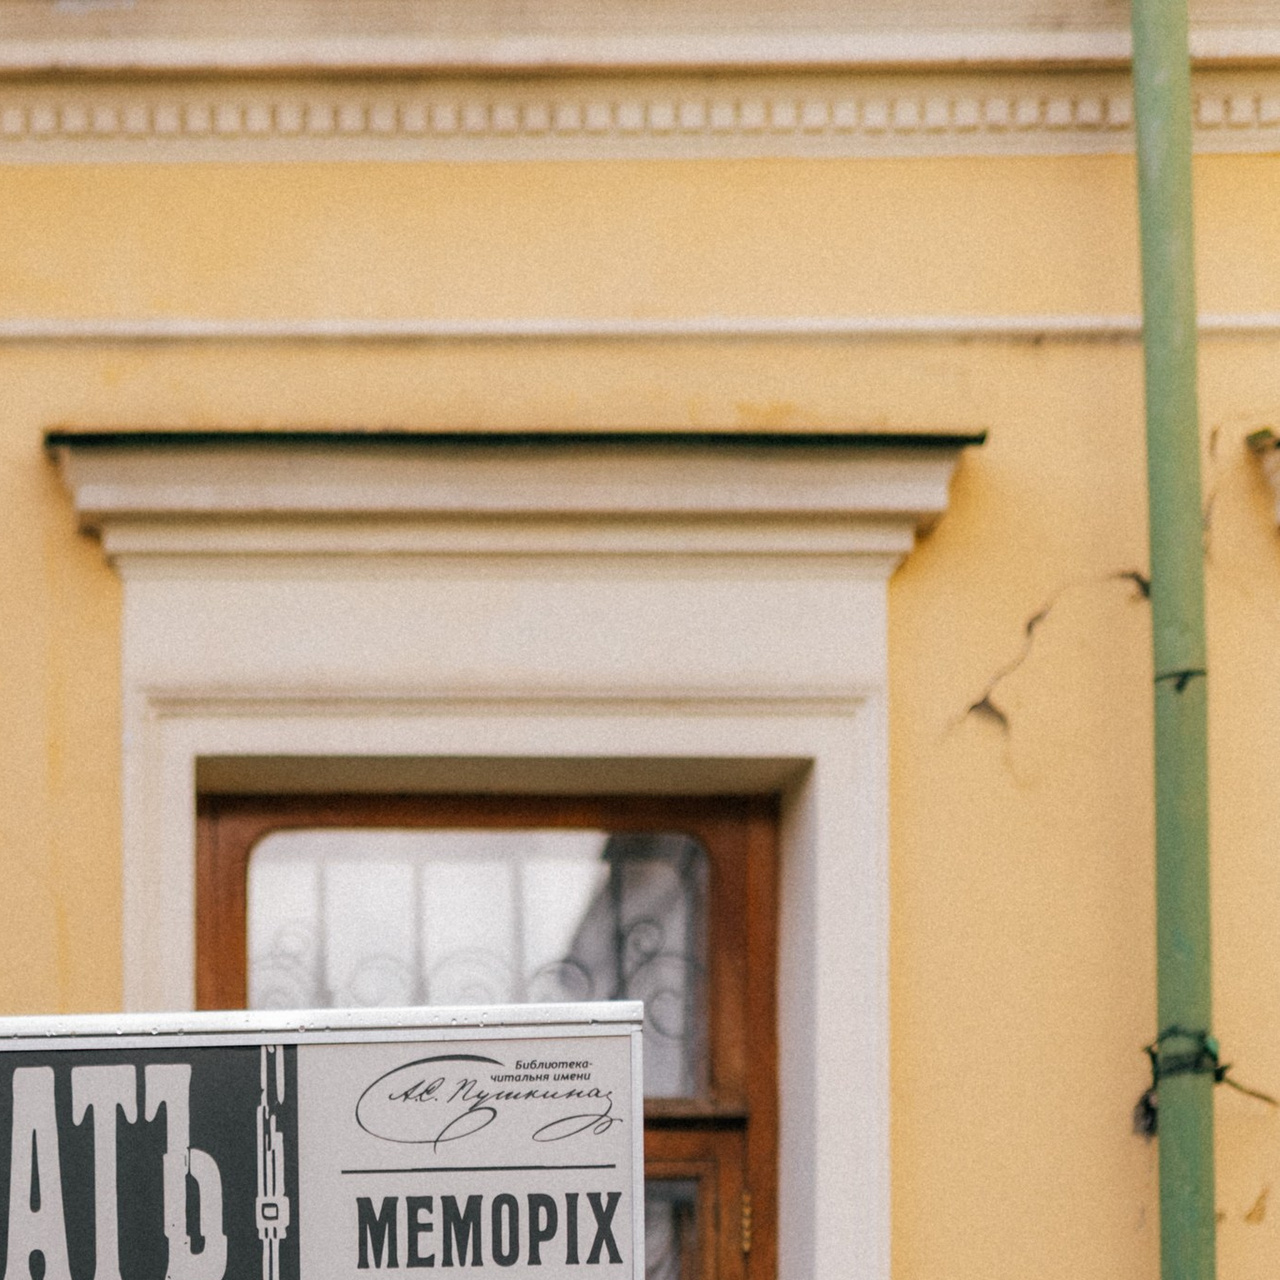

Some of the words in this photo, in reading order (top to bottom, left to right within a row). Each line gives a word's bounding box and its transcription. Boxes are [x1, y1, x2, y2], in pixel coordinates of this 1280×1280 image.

[515, 1060, 593, 1071] Библиотека-
[490, 1073, 549, 1083] читальня
[553, 1071, 591, 1082] имени
